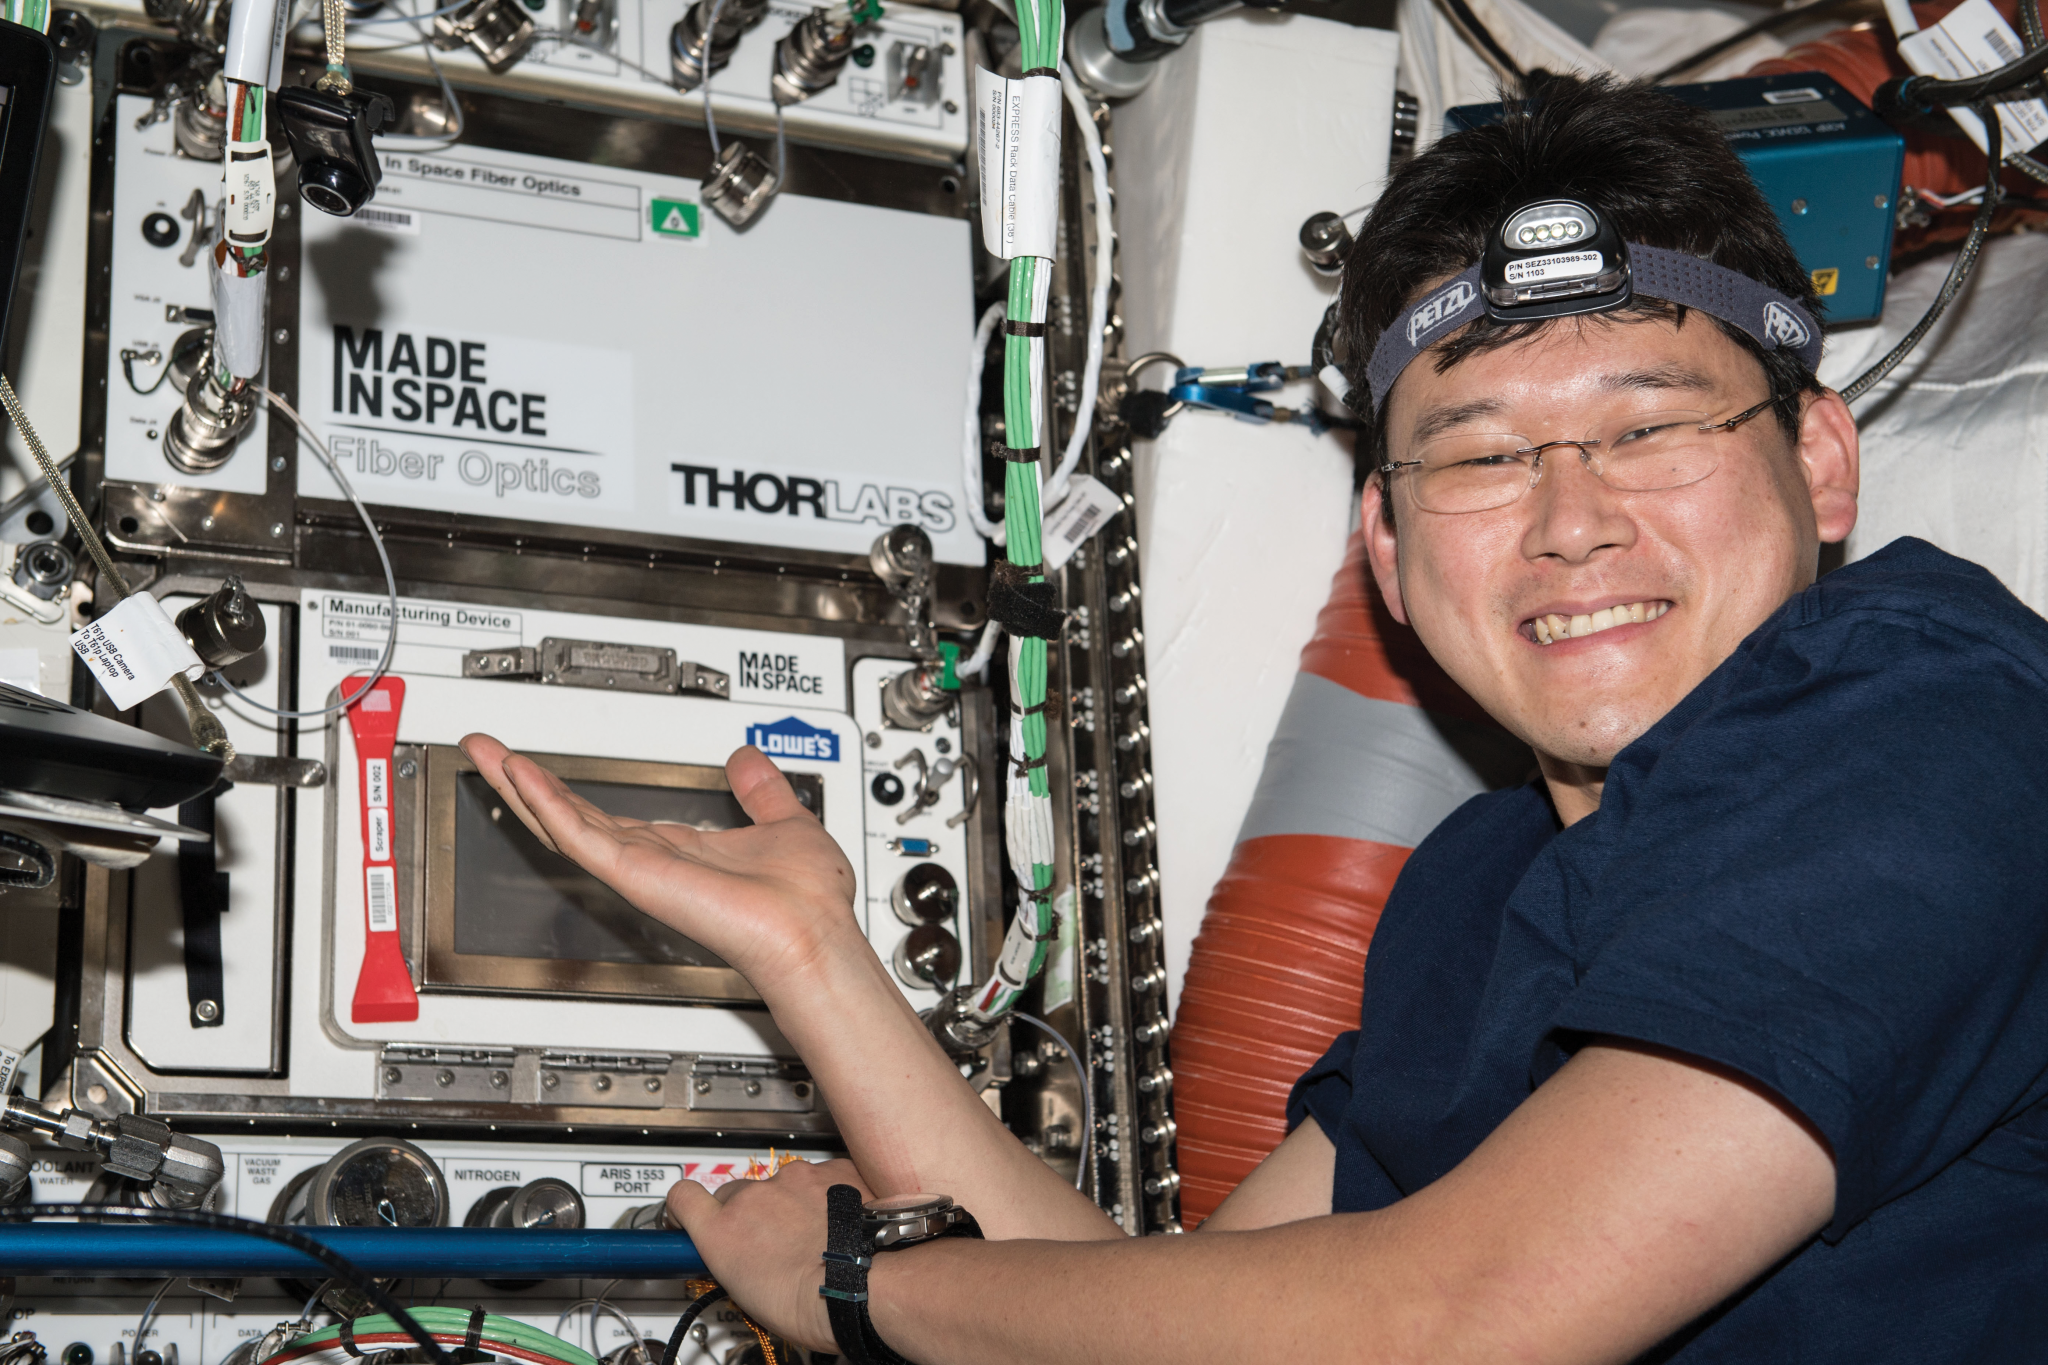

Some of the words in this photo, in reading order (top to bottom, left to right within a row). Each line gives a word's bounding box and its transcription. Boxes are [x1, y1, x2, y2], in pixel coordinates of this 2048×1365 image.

[1010, 95, 1020, 143] EXPRESS
[1009, 145, 1018, 168] Rack
[385, 155, 402, 170] In
[408, 159, 465, 180] Space
[471, 167, 517, 187] Fiber
[523, 175, 581, 197] Optics
[1009, 170, 1017, 192] Data
[1509, 263, 1523, 272] P/N
[1525, 254, 1598, 269] SEZ33103989-302
[1509, 271, 1524, 280] S/N
[1526, 268, 1545, 278] 1103
[1409, 284, 1477, 347] PETZL
[333, 324, 488, 385] MADE
[333, 372, 384, 418] IN
[391, 378, 548, 437] SPACE
[328, 434, 445, 481] Fiber
[458, 450, 601, 500] Optics
[671, 462, 957, 534] THORLABS
[456, 610, 512, 629] Device
[74, 640, 90, 655] USB
[80, 629, 90, 640] To
[88, 638, 102, 655] T61p
[98, 653, 119, 678] Laptop
[91, 623, 106, 641] T61p
[102, 639, 118, 655] USB
[113, 653, 136, 681] Camera
[739, 651, 799, 673] MADE
[740, 671, 759, 688] IN
[762, 672, 823, 694] SPACE
[755, 729, 832, 758] LOWE'S
[373, 765, 382, 782] 002
[373, 785, 382, 803] S/N
[375, 816, 386, 852] Scraper
[4, 1055, 16, 1065] To
[244, 1158, 281, 1167] VACUUM
[248, 1168, 277, 1176] WASTE
[39, 1177, 74, 1186] WATER
[252, 1177, 272, 1185] GAS
[454, 1169, 520, 1181] NITROGEN
[600, 1168, 631, 1180] ARIS
[635, 1169, 666, 1181] 1553
[613, 1181, 652, 1193] PORT
[121, 1329, 159, 1337] POER
[238, 1329, 263, 1338] DATA
